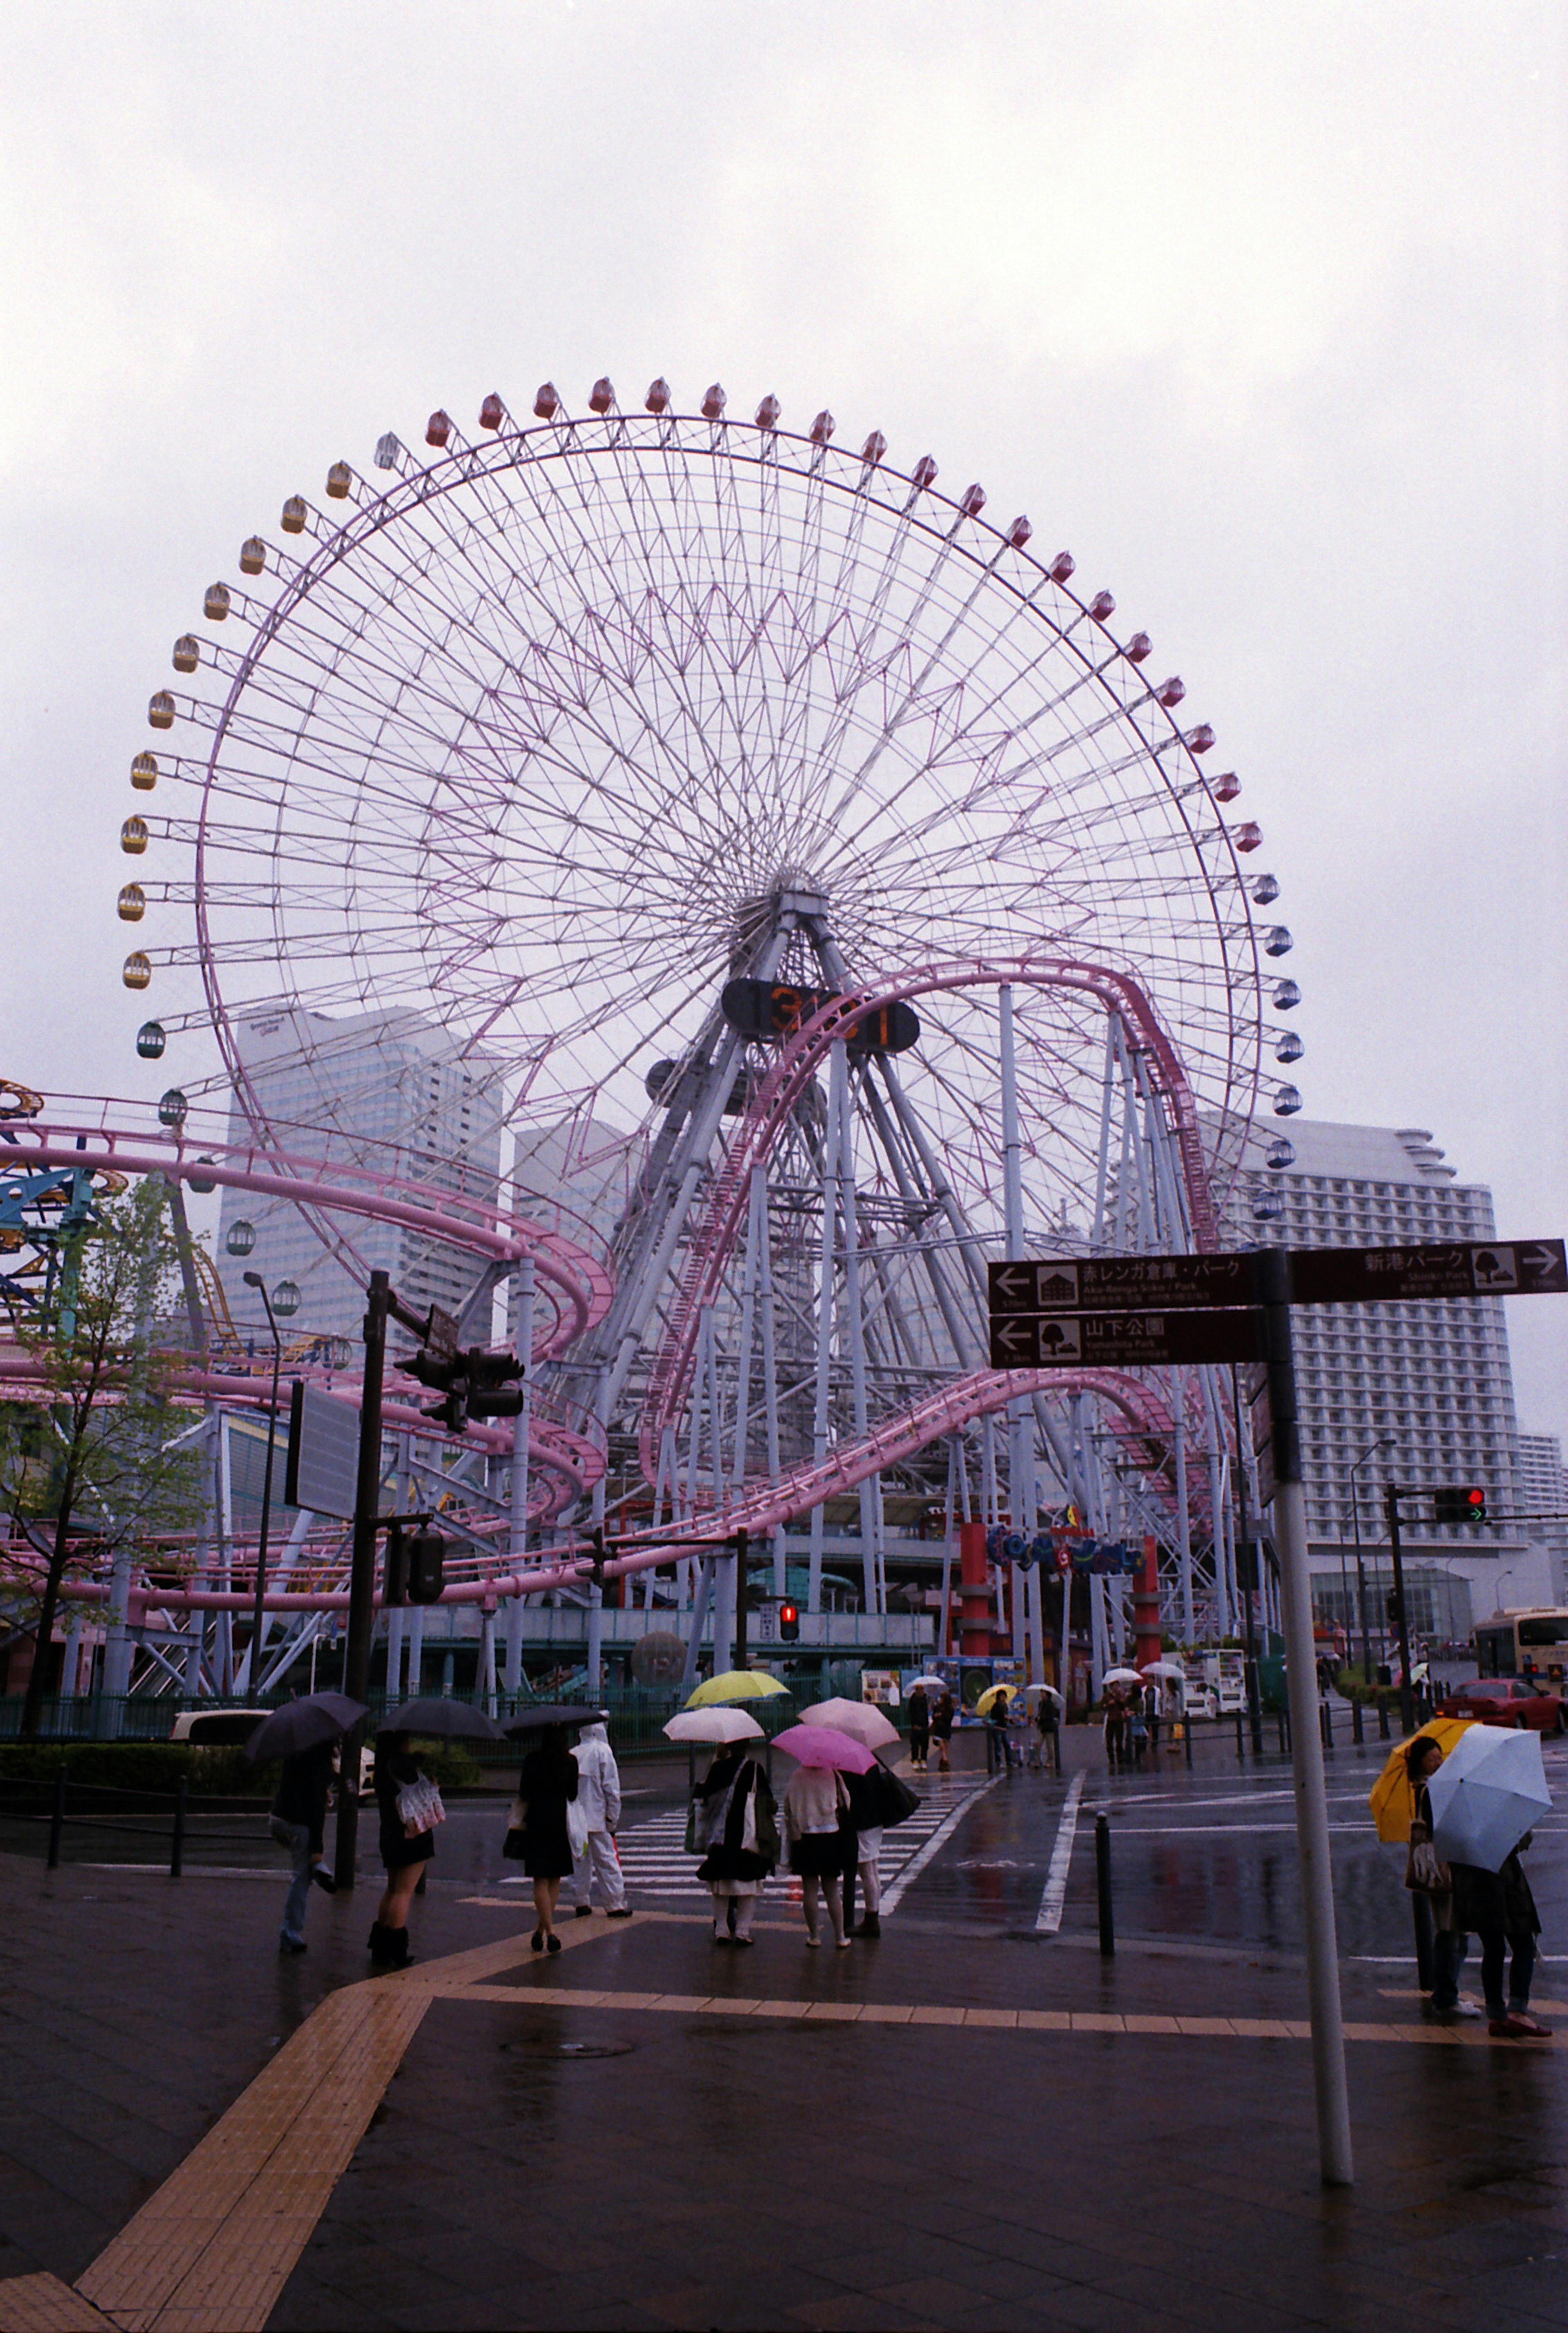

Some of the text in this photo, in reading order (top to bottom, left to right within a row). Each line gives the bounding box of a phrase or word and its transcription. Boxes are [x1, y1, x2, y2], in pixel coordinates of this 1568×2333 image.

[1365, 1250, 1463, 1272] 新港パーク
[1083, 1260, 1240, 1282] 赤レンガ倉庫・パーク
[1446, 1270, 1469, 1281] Park
[1083, 1284, 1138, 1295] Aka-Renga
[1174, 1281, 1197, 1291] Park
[1086, 1317, 1165, 1337] 山下公園
[1085, 1338, 1156, 1349] Yamashita Park
